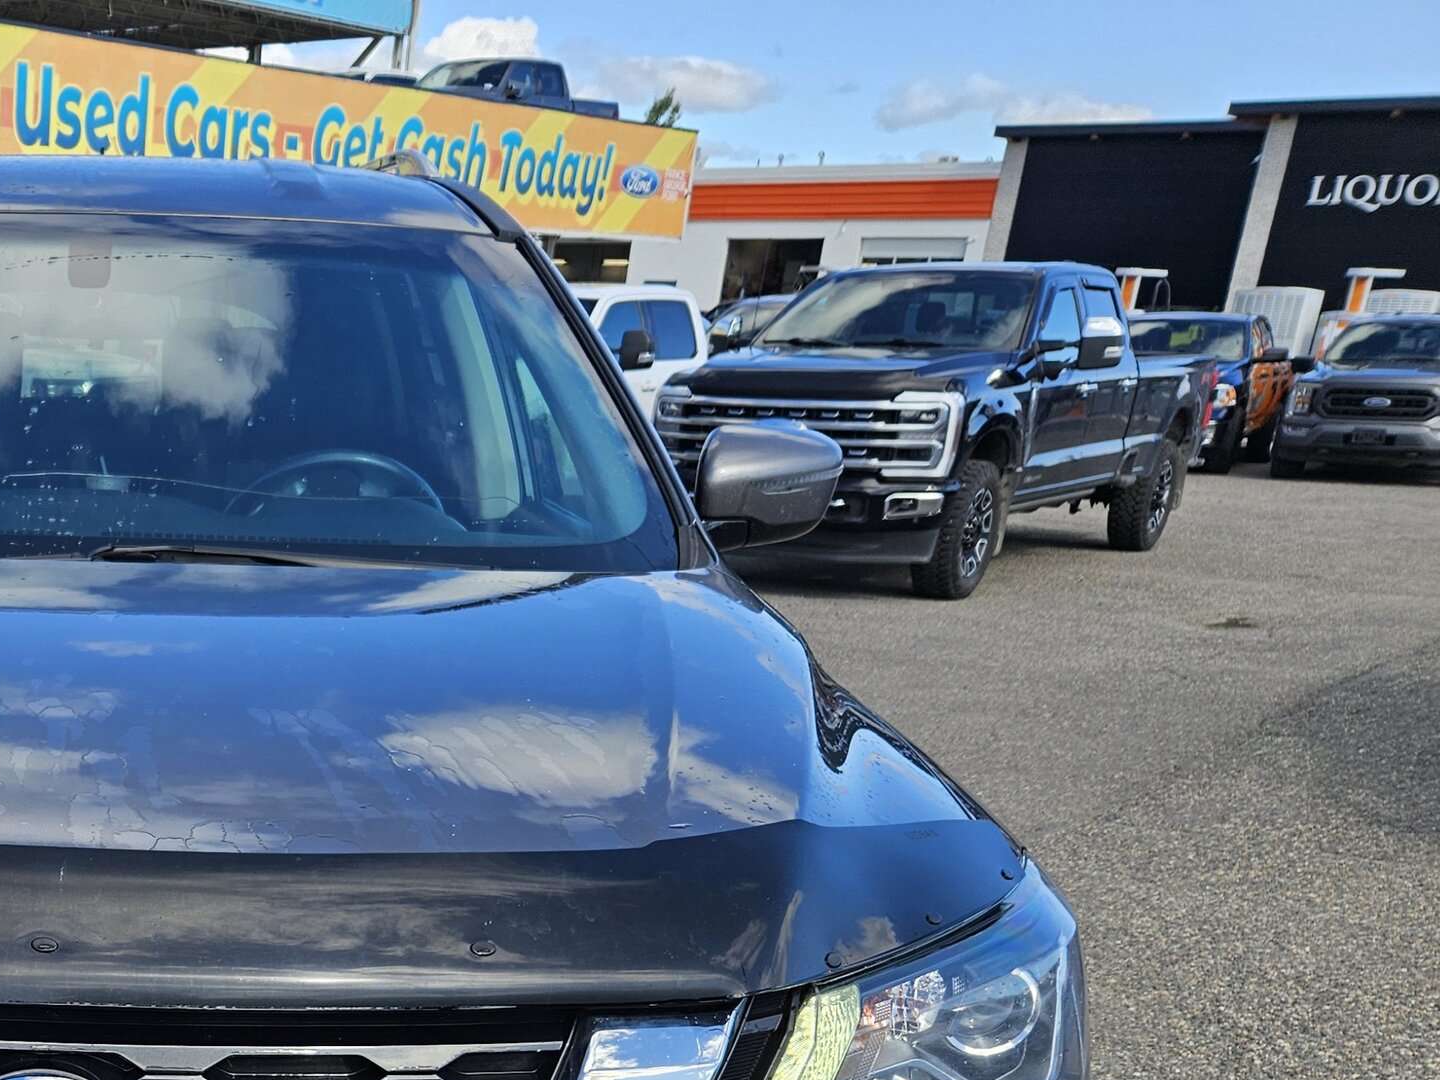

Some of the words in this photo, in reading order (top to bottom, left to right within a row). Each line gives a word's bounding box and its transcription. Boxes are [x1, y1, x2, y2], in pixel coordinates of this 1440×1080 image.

[15, 61, 151, 157] Used
[165, 83, 273, 160] Cars
[313, 106, 385, 169] Get
[498, 131, 616, 216] Today!
[1306, 173, 1440, 213] LIQUO
